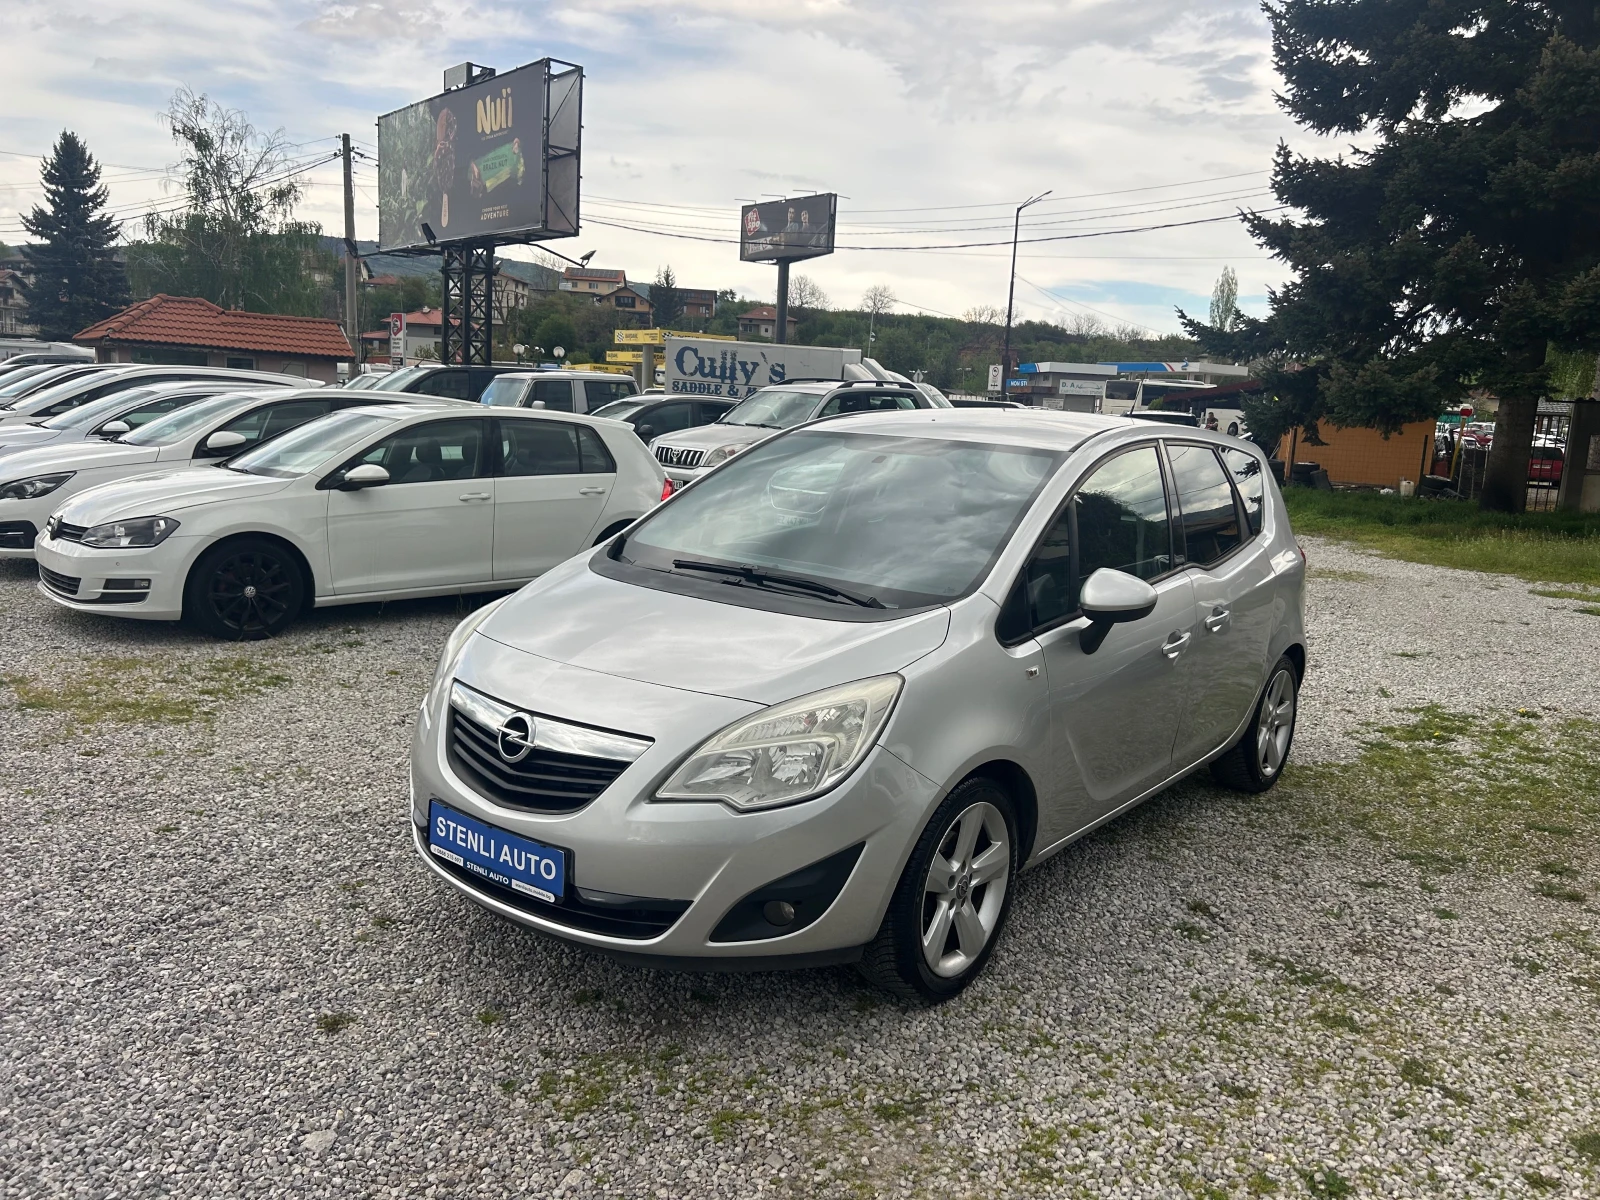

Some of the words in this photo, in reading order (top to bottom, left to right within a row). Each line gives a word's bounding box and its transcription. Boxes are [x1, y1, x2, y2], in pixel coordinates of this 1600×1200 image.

[481, 209, 509, 220] ADVENTURE
[672, 381, 722, 395] SADDLE
[727, 384, 739, 396] &
[436, 816, 495, 859] STENLI
[499, 844, 557, 880] AUTO
[466, 861, 488, 876] STENLI
[489, 871, 509, 885] AUTO
